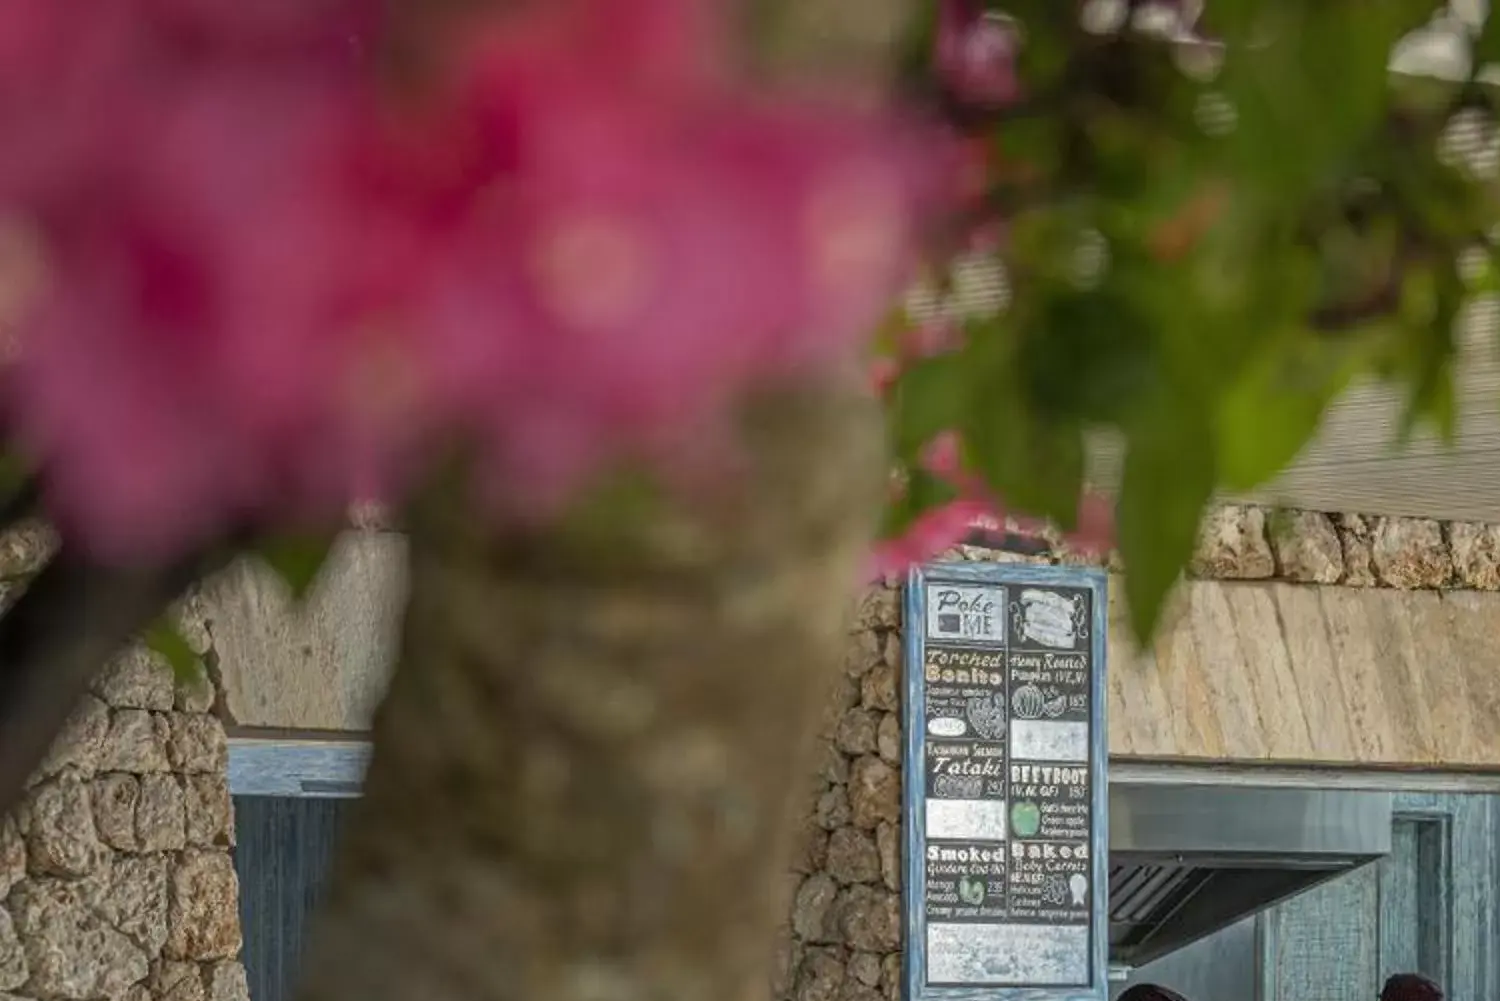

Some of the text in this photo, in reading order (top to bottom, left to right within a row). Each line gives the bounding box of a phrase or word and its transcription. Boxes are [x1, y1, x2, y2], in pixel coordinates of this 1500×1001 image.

[938, 590, 994, 612] Poke
[927, 651, 1003, 667] Torched
[925, 664, 1003, 686] Bonito
[932, 757, 1003, 776] Tataki
[1011, 765, 1089, 785] BEETROOT
[927, 845, 1005, 863] Smoked
[1011, 842, 1089, 860] Baked
